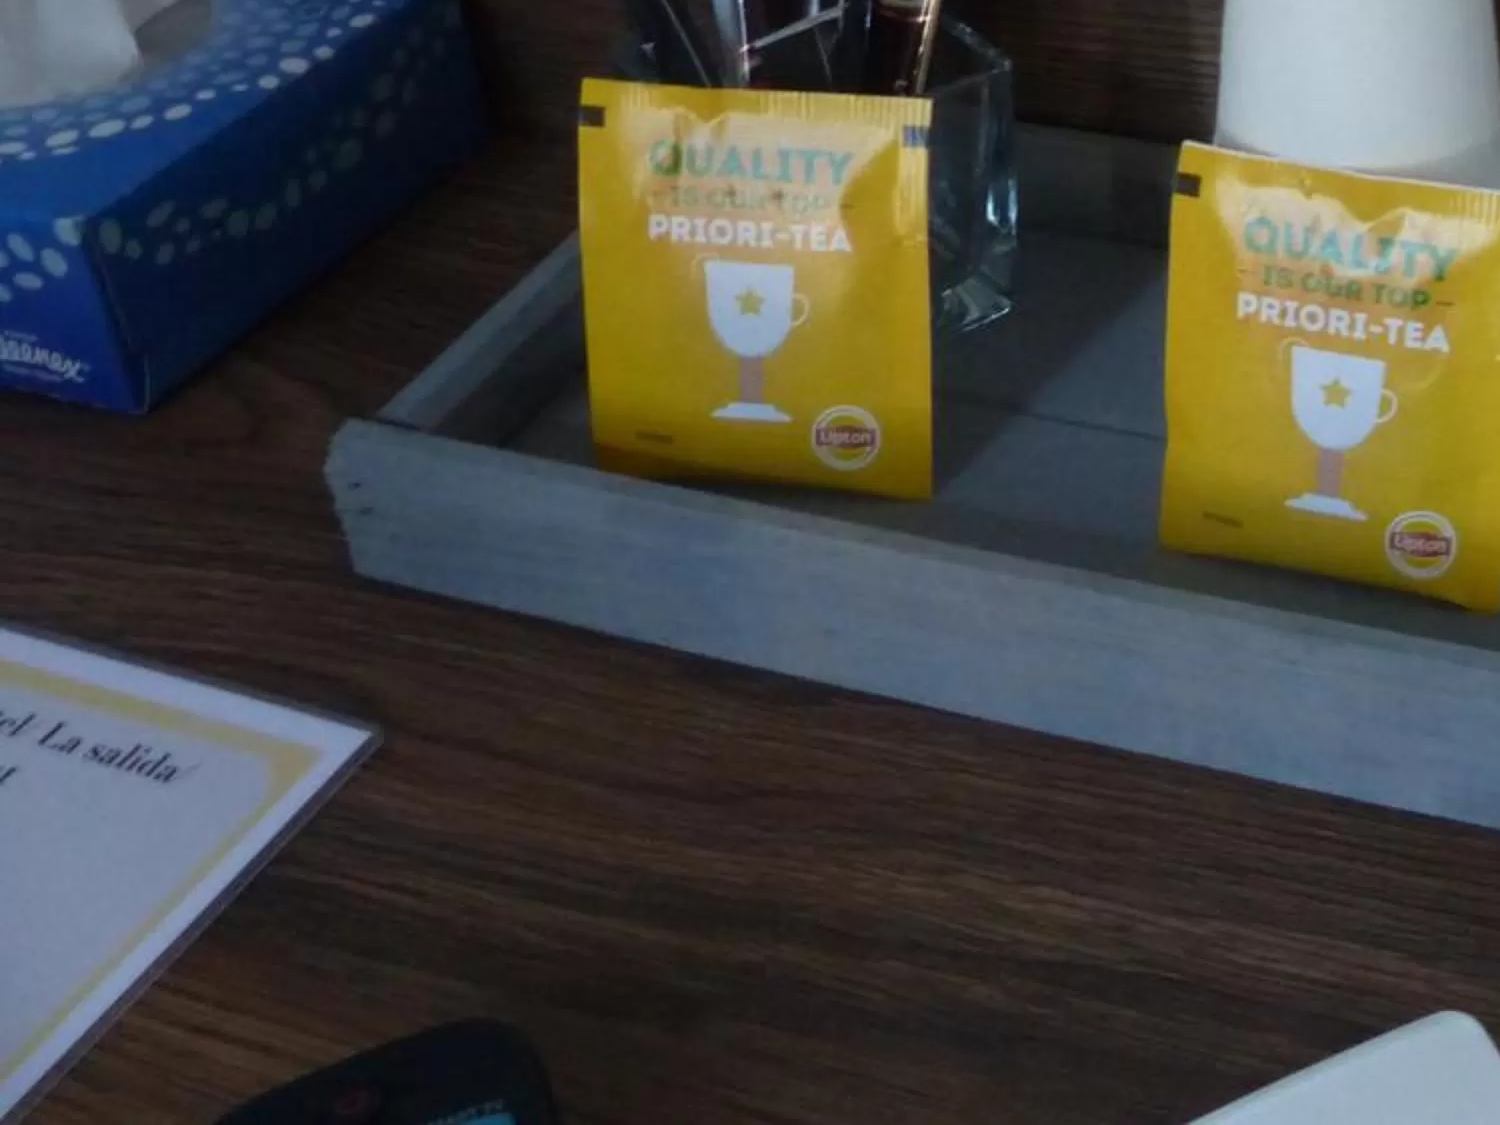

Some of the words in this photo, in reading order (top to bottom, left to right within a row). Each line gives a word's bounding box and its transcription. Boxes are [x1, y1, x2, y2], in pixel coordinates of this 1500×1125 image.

[648, 137, 856, 188] QUALITY
[648, 213, 854, 258] PRIORI-TEA
[1243, 215, 1460, 284] QUALITY
[1263, 264, 1295, 289] IS
[1302, 271, 1363, 302] OUR
[1372, 282, 1433, 312] TOP
[1235, 291, 1451, 354] PRIORI-TEA
[818, 429, 873, 447] Lipton
[1393, 534, 1447, 554] Lipton
[38, 720, 83, 754] La
[83, 742, 181, 784] salida
